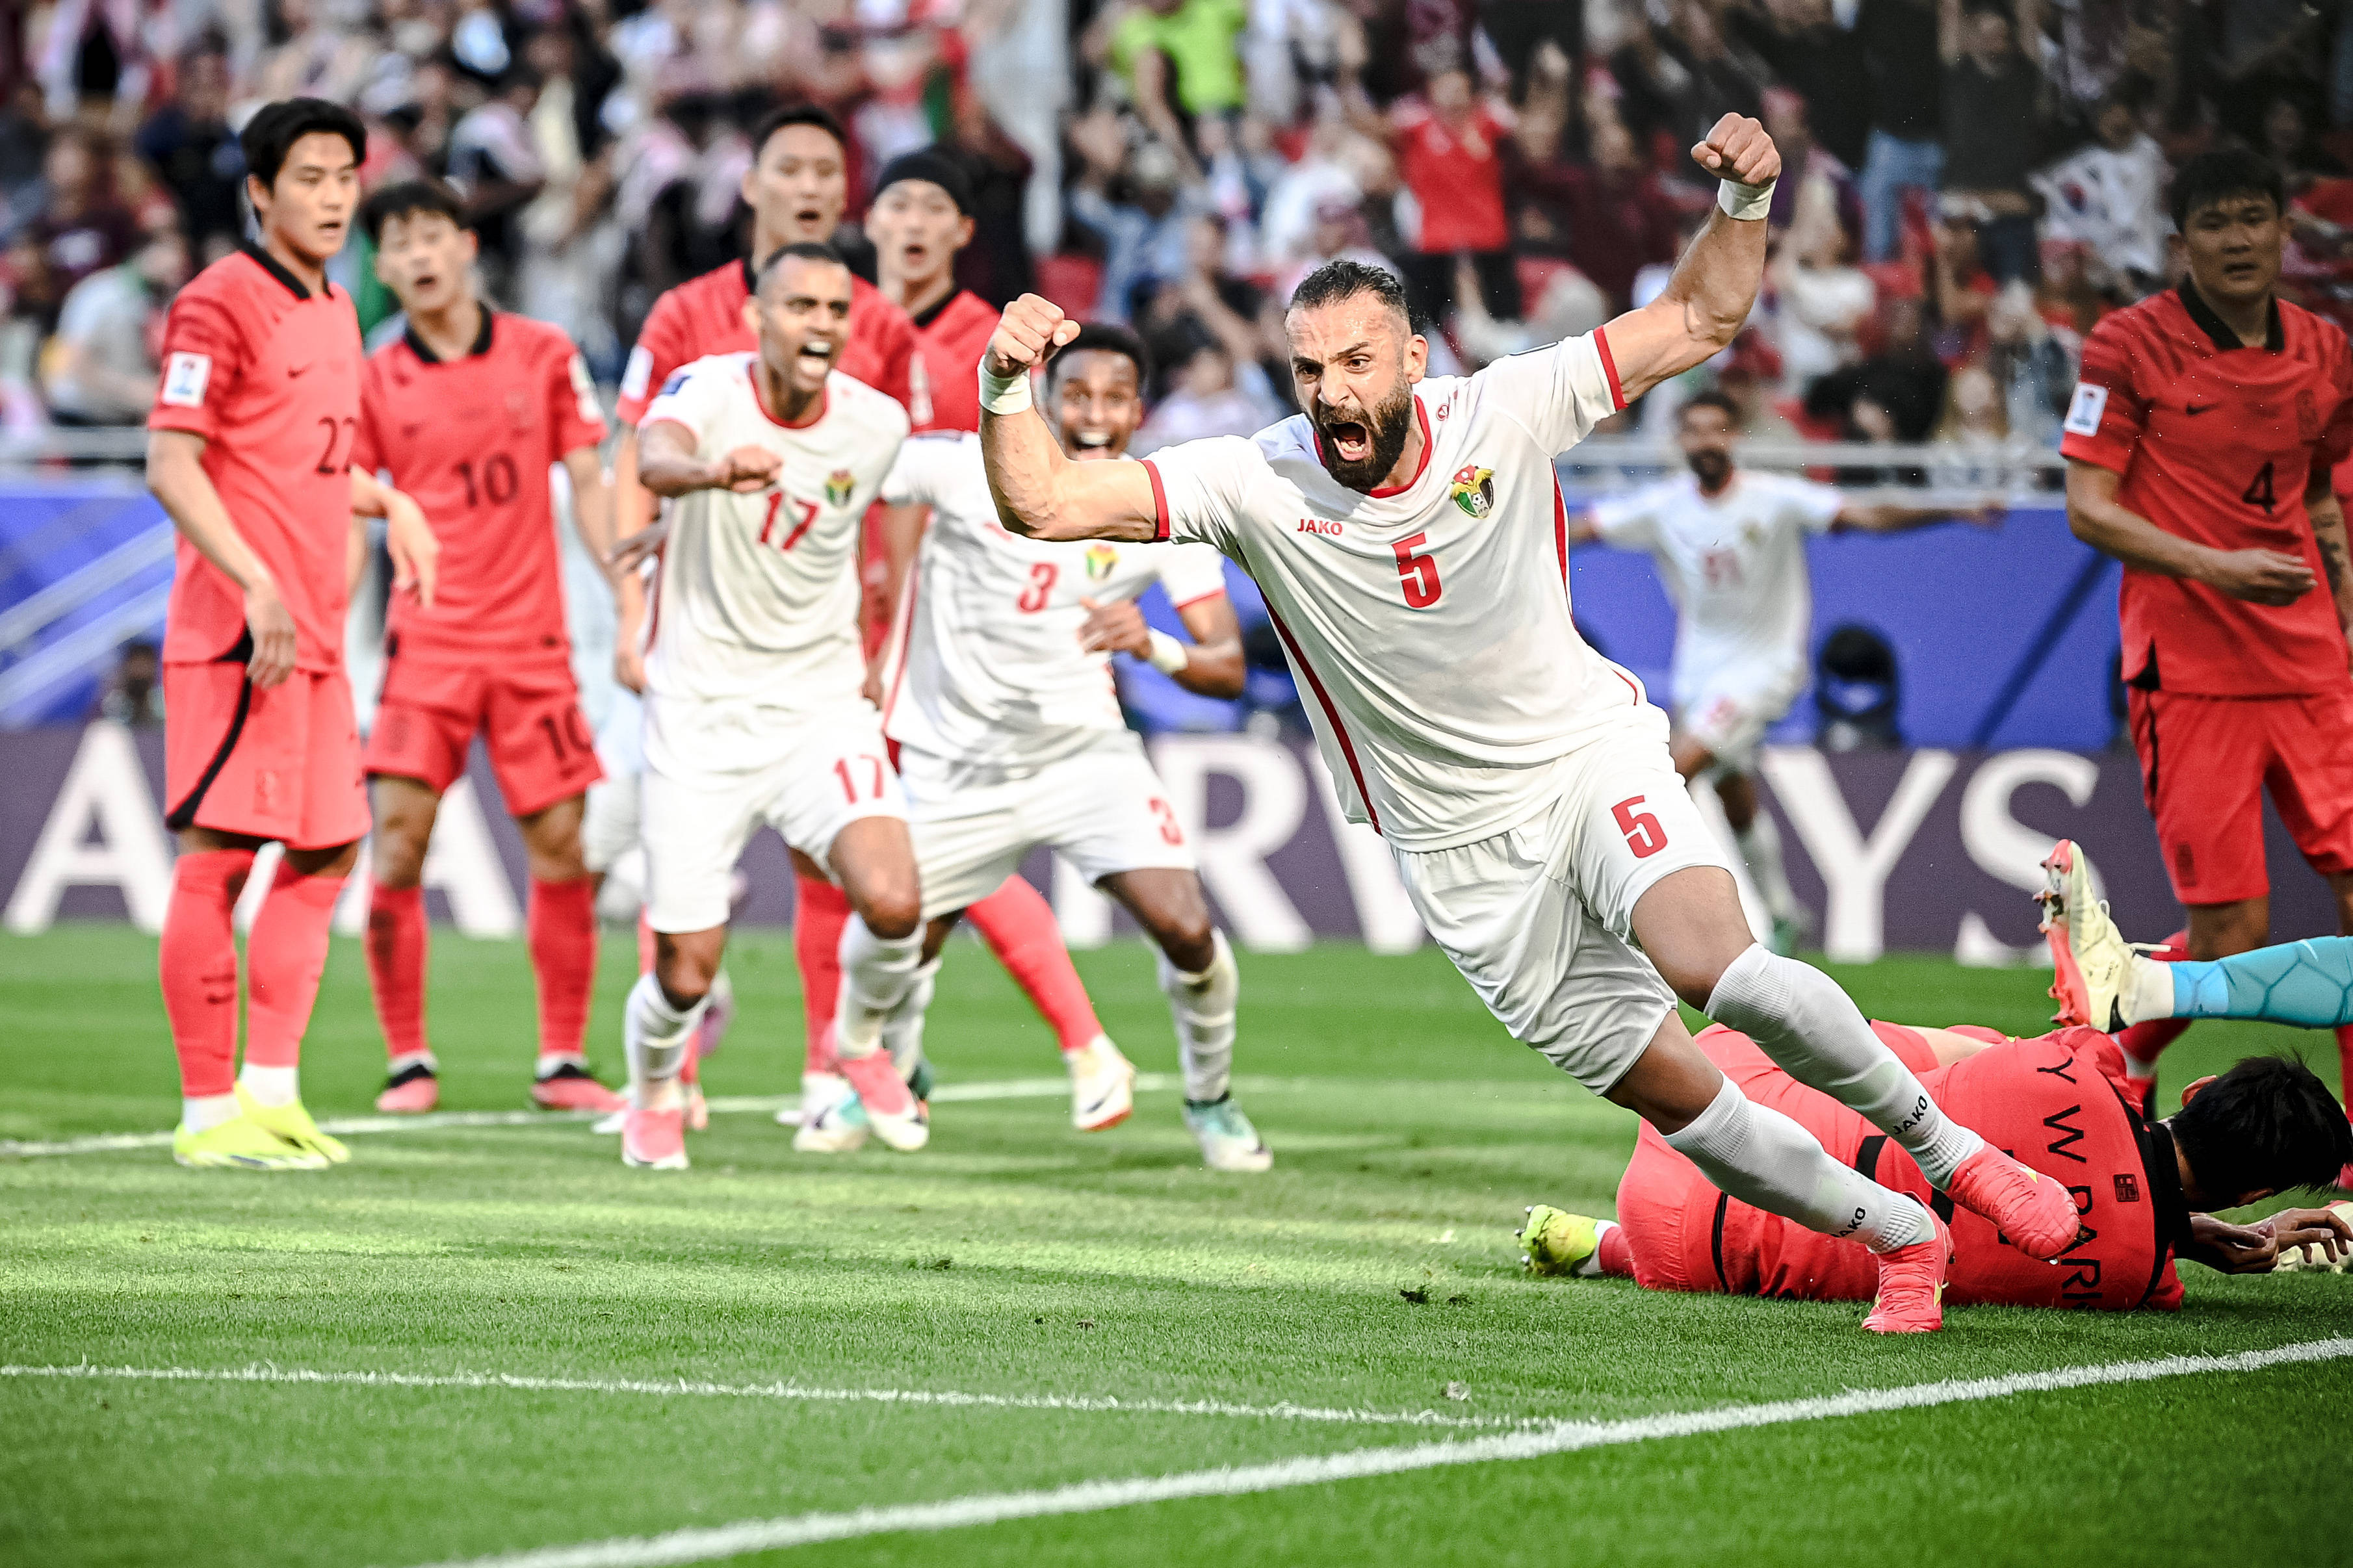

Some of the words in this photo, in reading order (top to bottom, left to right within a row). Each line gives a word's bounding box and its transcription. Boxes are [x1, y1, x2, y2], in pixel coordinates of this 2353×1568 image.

[454, 452, 518, 508] 10
[2242, 462, 2277, 514] 4
[759, 491, 819, 551] 17
[1297, 519, 1343, 536] JAKO
[1017, 562, 1059, 613] 3
[1392, 532, 1442, 608] 5
[537, 702, 592, 760] 10
[833, 753, 885, 805] 17
[1149, 797, 1184, 846] 3
[1611, 795, 1668, 858] 5
[2036, 1057, 2077, 1085] Y
[1893, 1095, 1928, 1135] JAKO
[2043, 1105, 2087, 1163] W
